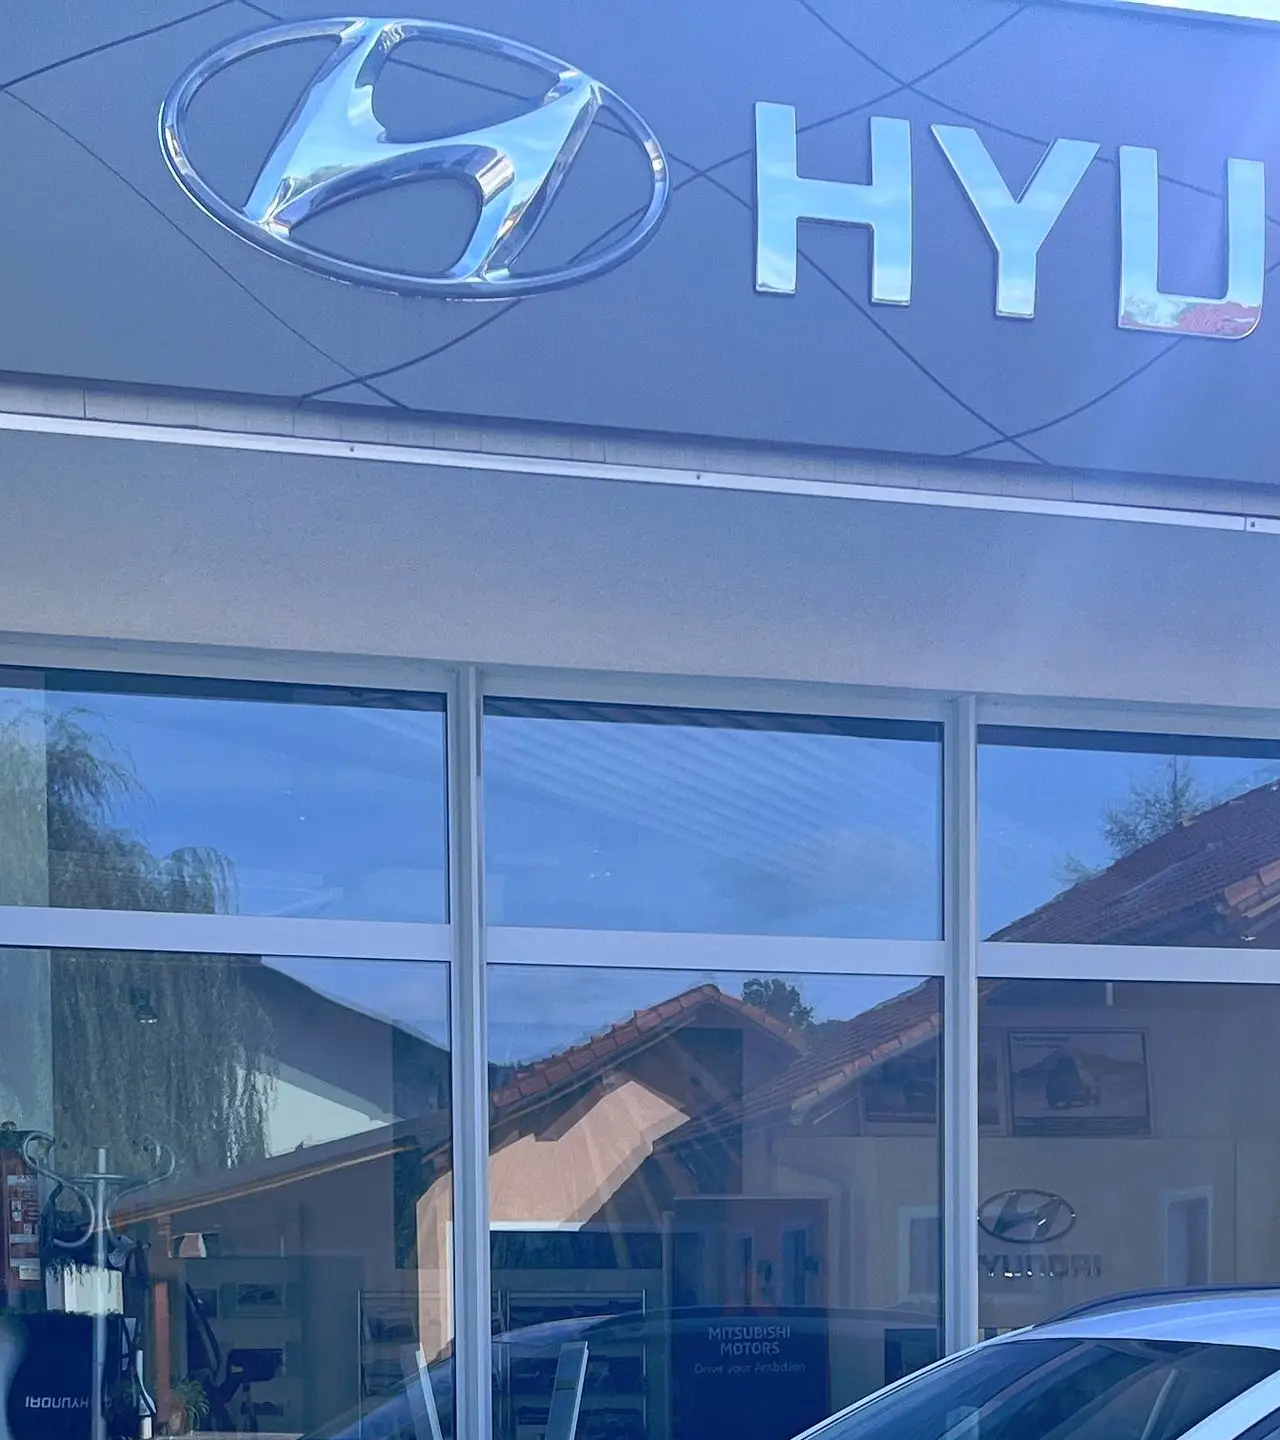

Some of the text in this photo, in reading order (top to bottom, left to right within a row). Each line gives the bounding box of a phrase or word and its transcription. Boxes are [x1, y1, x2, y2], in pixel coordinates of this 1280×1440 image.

[978, 1253, 1102, 1278] YUNDAI
[708, 1325, 791, 1340] MITSUBISHI
[720, 1341, 780, 1356] MOTORS
[25, 1395, 89, 1409] HYUNDAI
